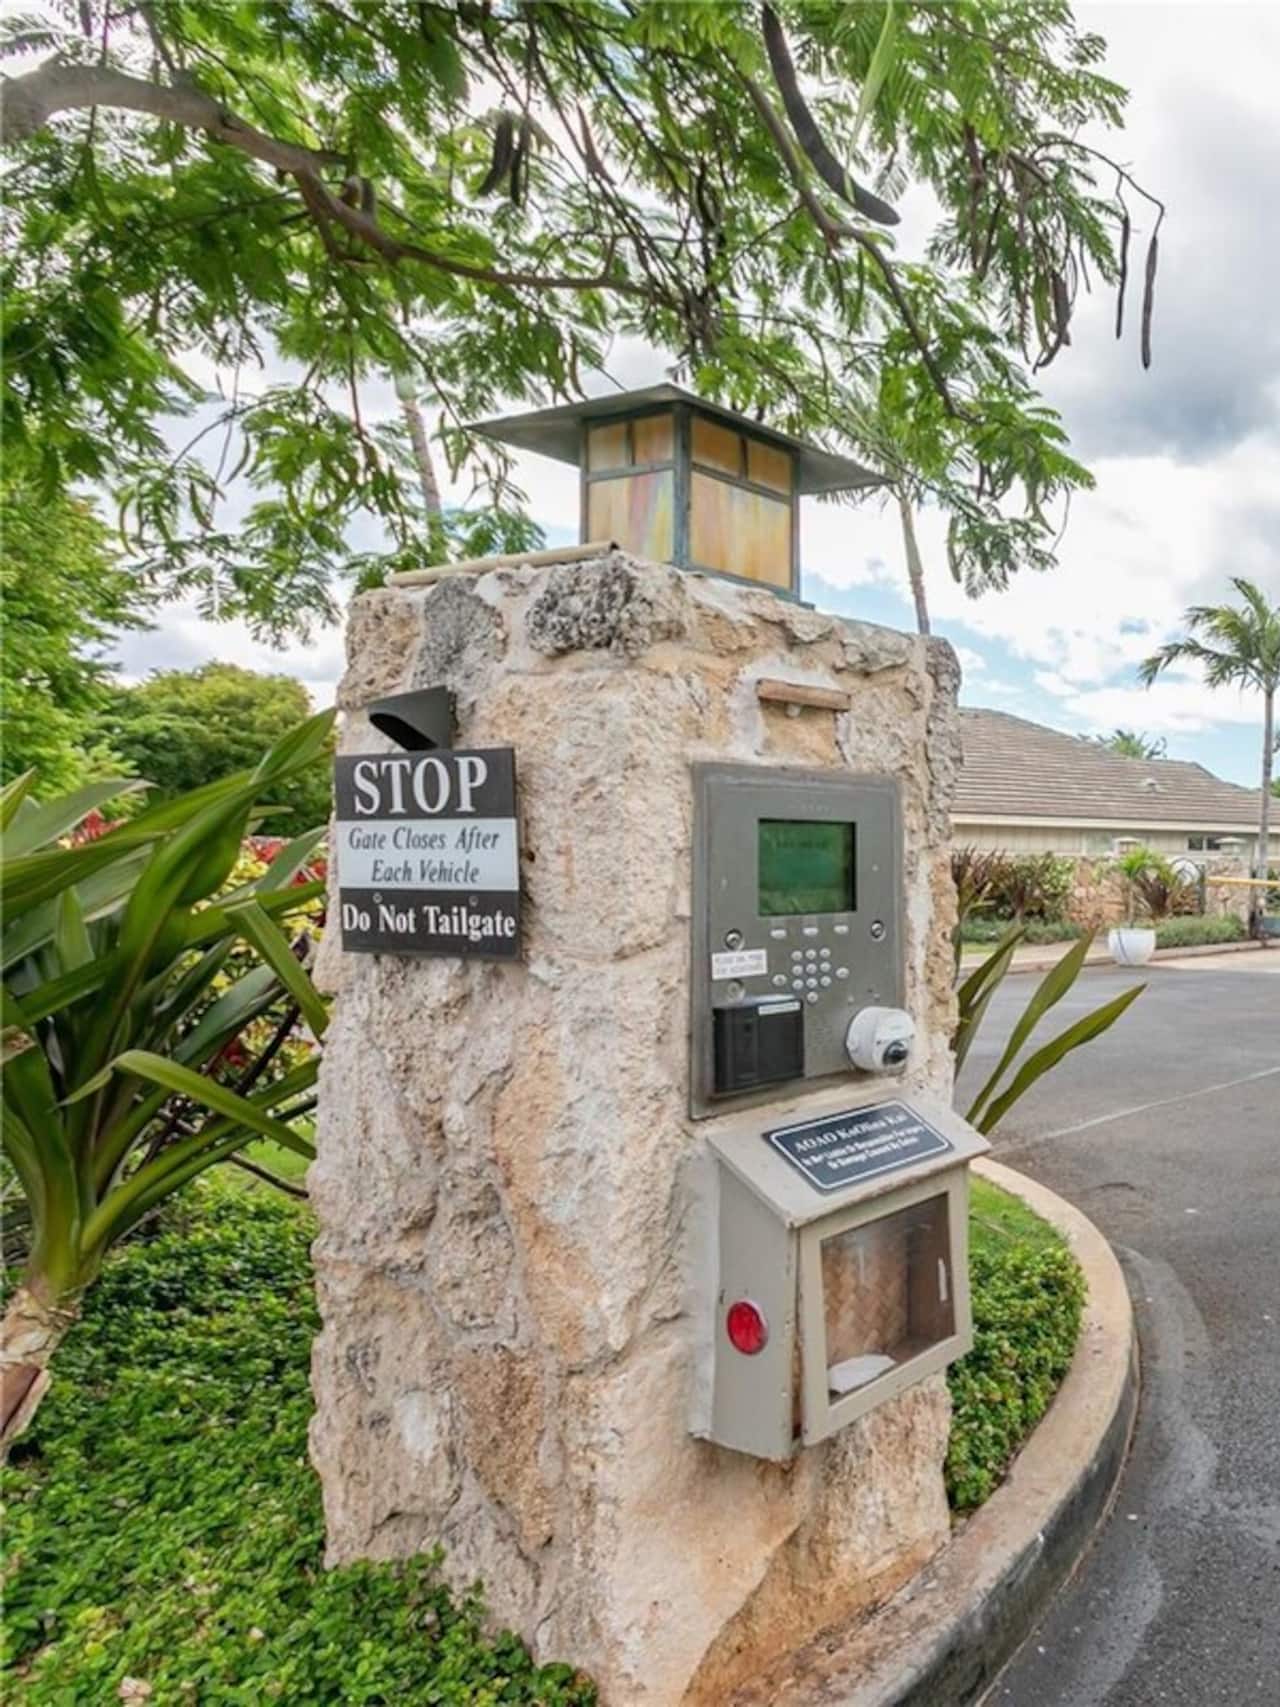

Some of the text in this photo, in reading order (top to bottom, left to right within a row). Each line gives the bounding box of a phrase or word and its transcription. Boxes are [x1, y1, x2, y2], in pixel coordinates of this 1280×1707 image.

[353, 756, 488, 815] STOP
[349, 826, 500, 854] Gate Closes After
[371, 859, 480, 884] Each Vehicle
[342, 904, 516, 942] Do Not Tailgate
